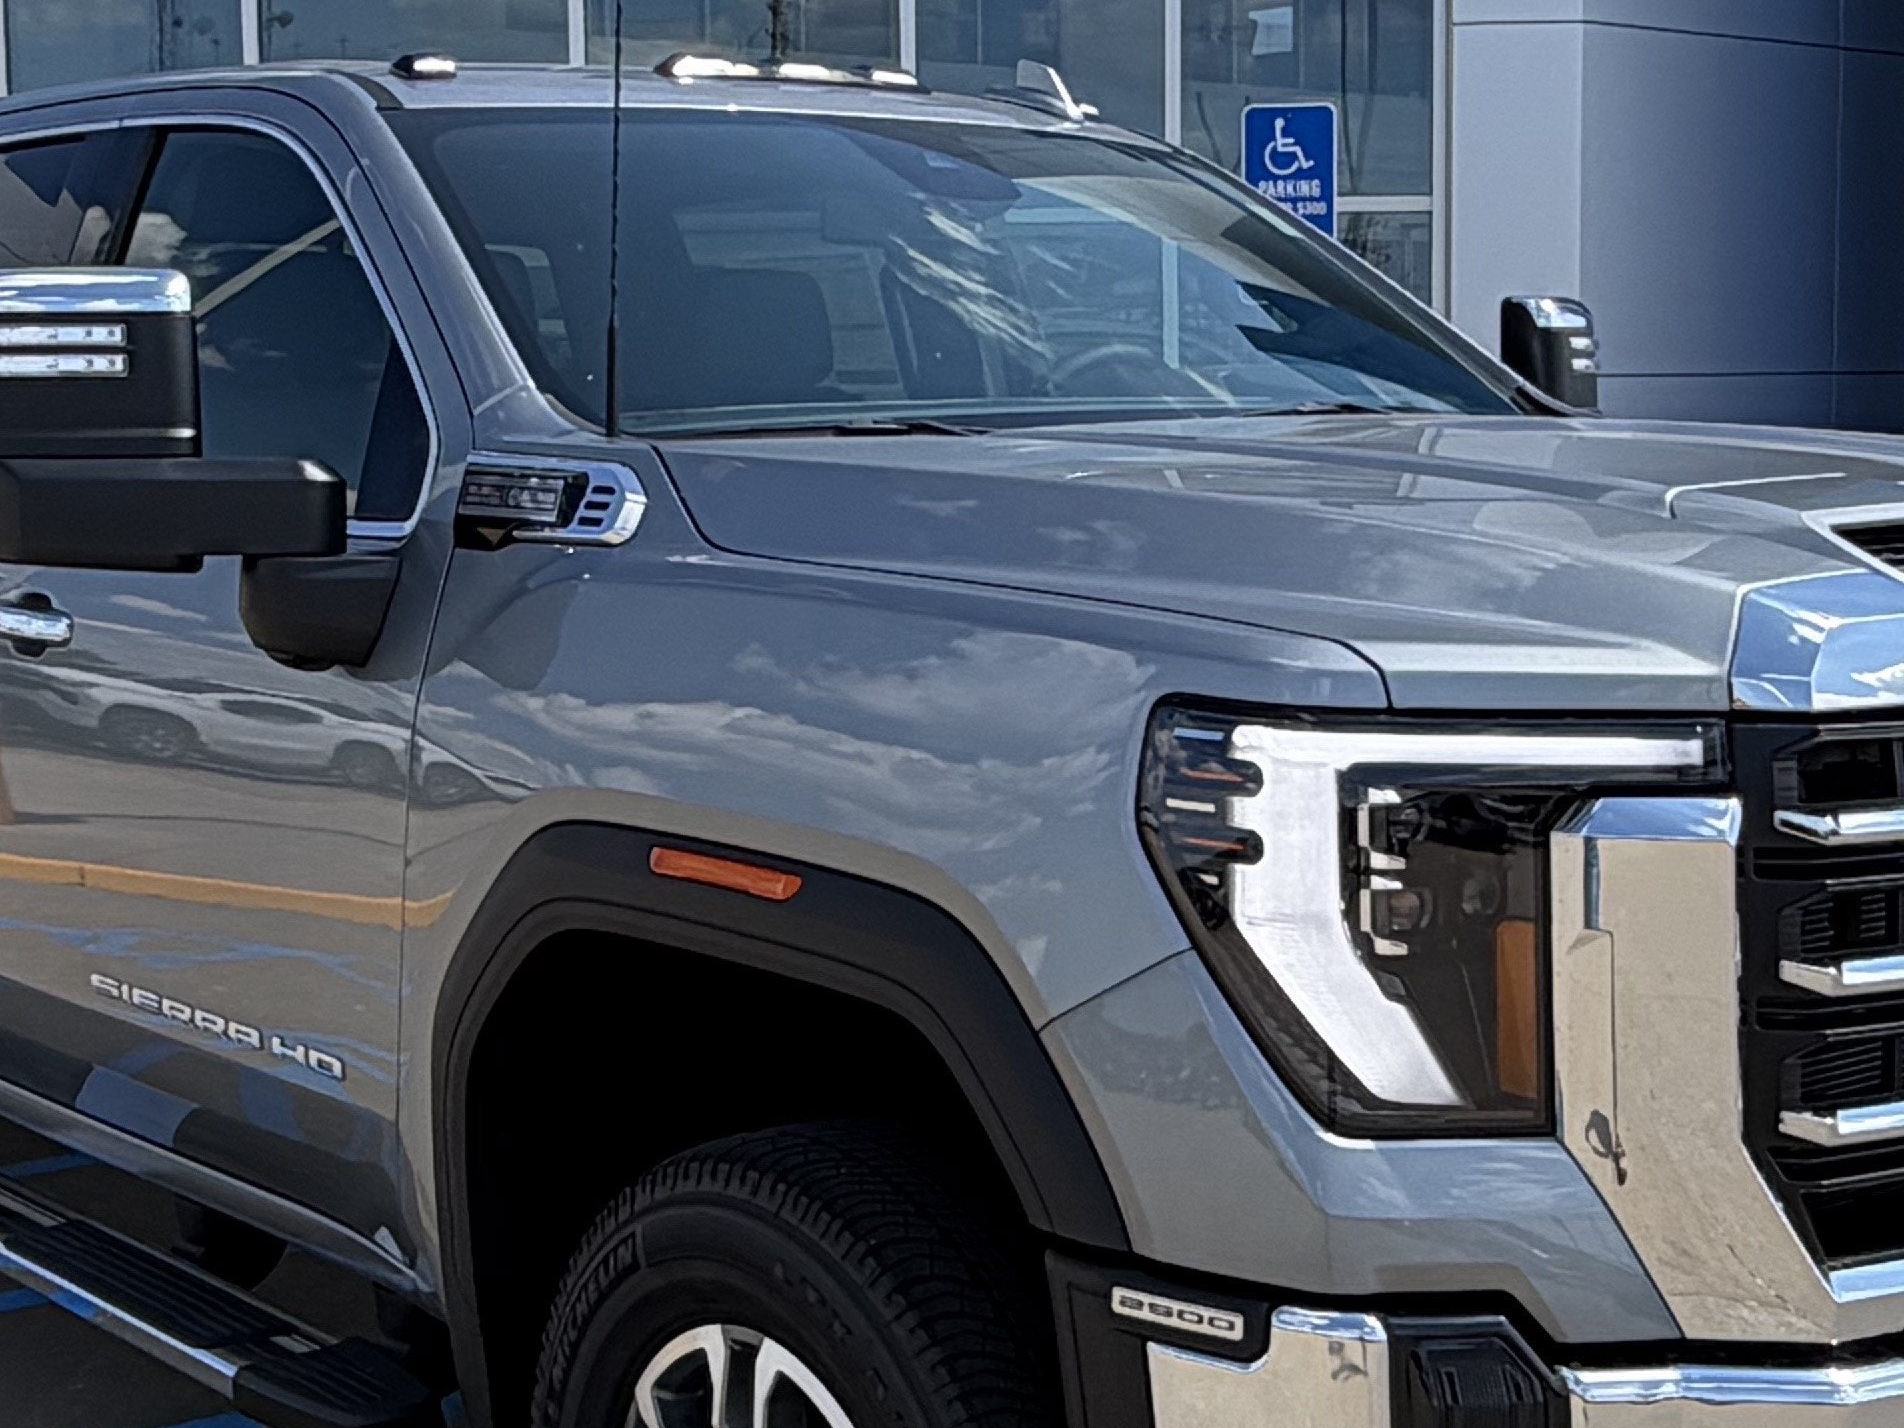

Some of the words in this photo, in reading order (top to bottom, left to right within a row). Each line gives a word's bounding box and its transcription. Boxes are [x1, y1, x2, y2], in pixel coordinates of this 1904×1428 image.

[1258, 179, 1321, 199] PARKING
[90, 972, 264, 1050] SIERRA
[271, 1035, 347, 1081] HD
